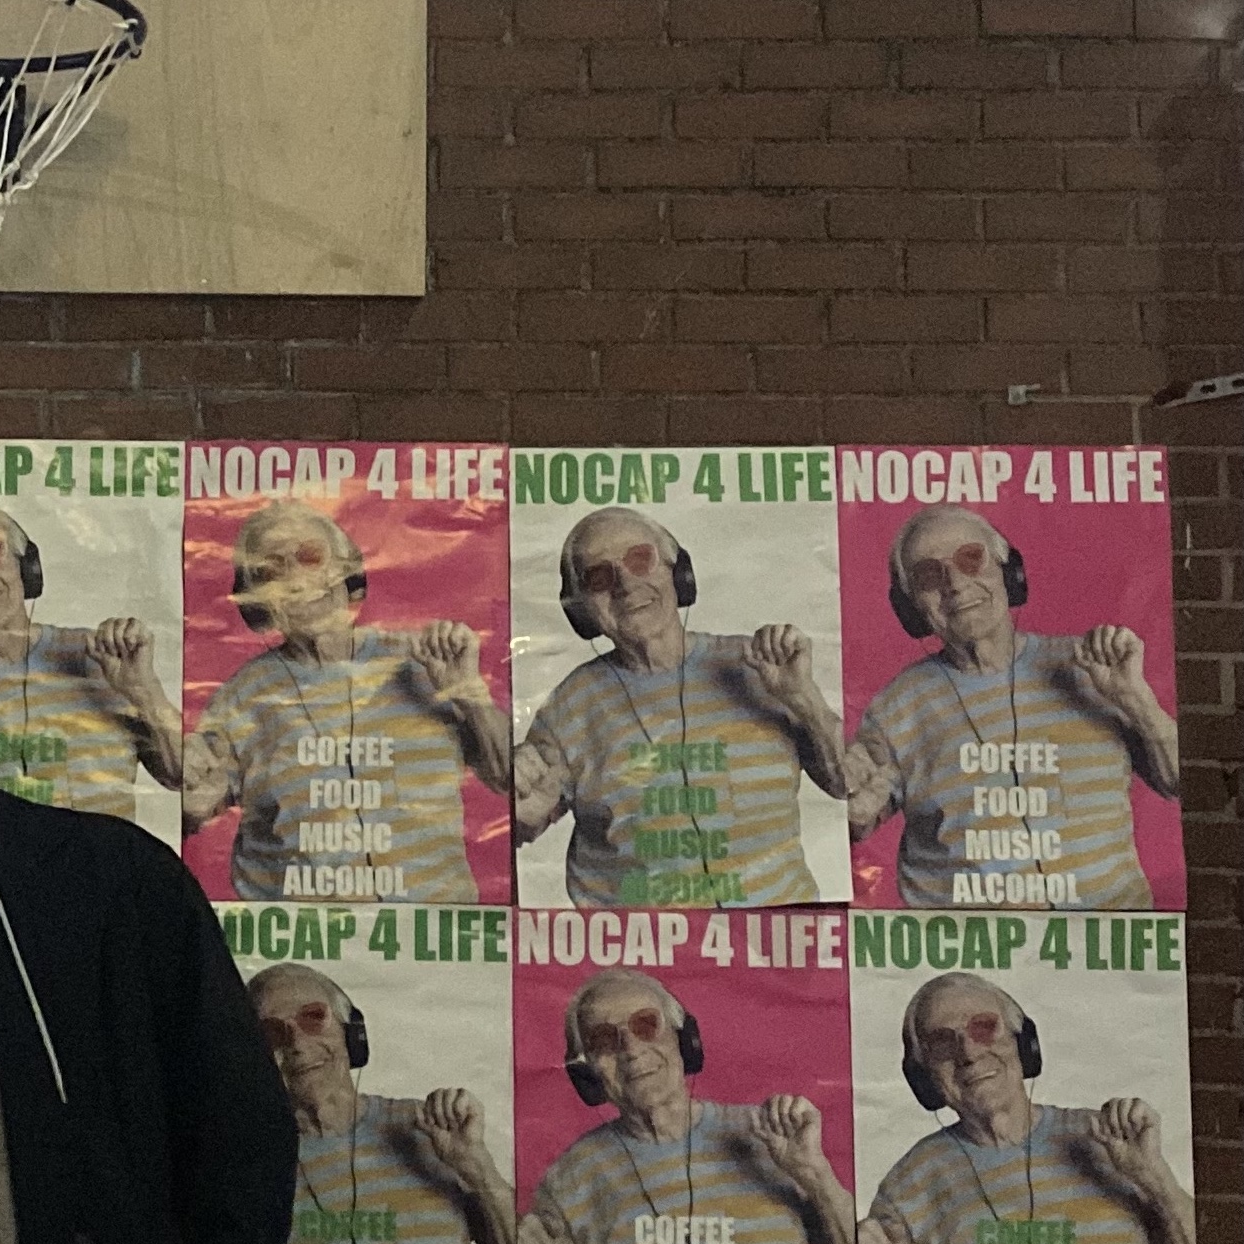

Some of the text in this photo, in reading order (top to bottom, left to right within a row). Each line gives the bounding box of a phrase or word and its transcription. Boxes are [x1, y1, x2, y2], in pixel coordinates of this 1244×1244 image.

[45, 447, 76, 496] 4
[89, 447, 180, 497] LIFE
[190, 447, 504, 499] NOCAP 4 LIFE
[515, 452, 833, 504] NOCAP 4 LIFE
[841, 449, 1165, 503] NOCAP 4 LIFE
[297, 735, 394, 767] COFFEE
[959, 742, 1058, 774] COFFEE
[309, 778, 381, 809] FOOD
[643, 786, 717, 815] FOOD
[973, 786, 1047, 817] FOOD
[299, 822, 392, 853] MUSIC
[634, 828, 729, 860] MUSIC
[964, 830, 1061, 861] MUSIC
[283, 864, 407, 896] ALCOHOL
[952, 873, 1081, 904] ALCOHOL
[223, 907, 507, 962] OCAP 4 LIFE
[518, 911, 843, 968] NOCAP 4 LIFE
[855, 915, 1181, 971] NOCAP 4 LIFE
